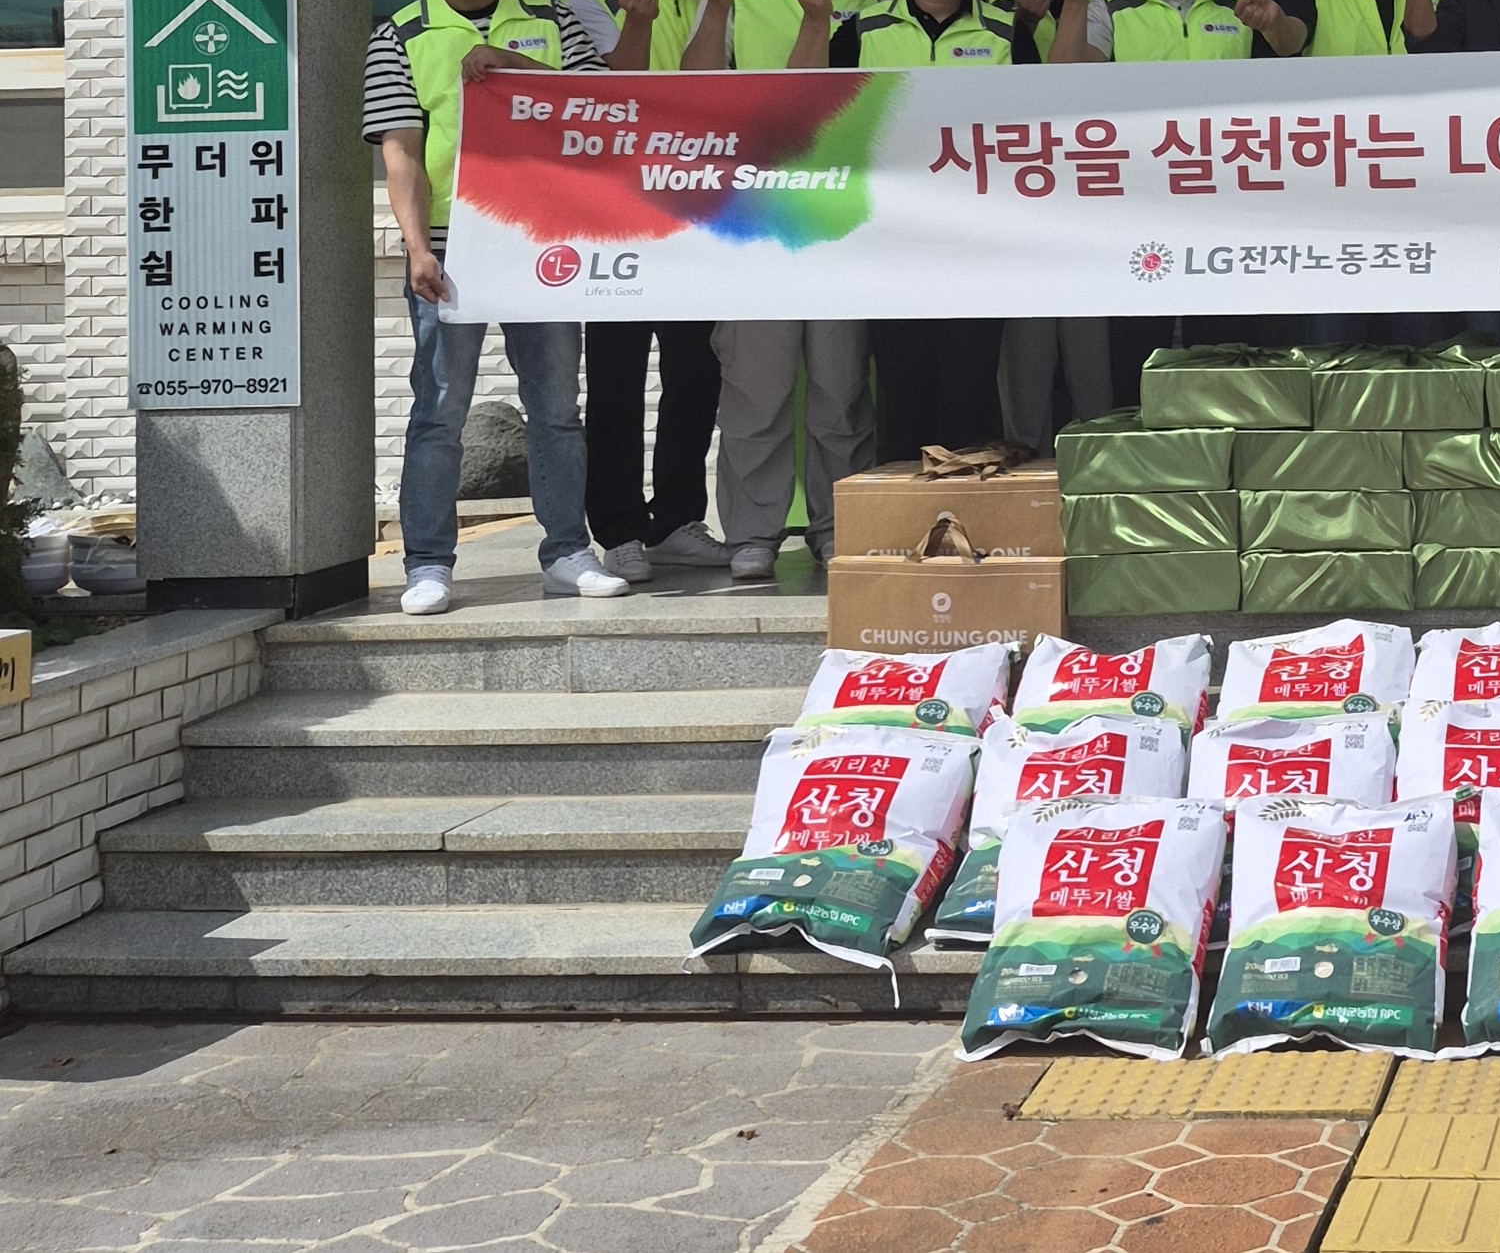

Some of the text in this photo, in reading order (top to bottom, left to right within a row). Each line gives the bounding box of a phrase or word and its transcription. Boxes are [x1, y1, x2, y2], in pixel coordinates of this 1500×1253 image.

[511, 95, 640, 123] Be First
[561, 129, 740, 162] Do it Right
[929, 118, 1130, 198] 사랑을
[1151, 113, 1425, 196] 실천하는
[640, 164, 851, 192] Work Smart!
[588, 251, 641, 281] LG
[1184, 240, 1437, 277] LG전자노동조합
[615, 286, 644, 297] Good
[161, 294, 270, 311] COOLING
[159, 320, 272, 336] WARMING
[168, 346, 264, 362] CENTER
[154, 377, 288, 396] 055-970-8921
[849, 686, 927, 701] 메뚜기쌀
[1063, 677, 1140, 693] 메뚜기쌀
[1273, 682, 1351, 697] 메뚜기쌀
[822, 757, 892, 775] 지리산
[792, 783, 887, 828] 산청
[1049, 847, 1146, 886] 산청
[1282, 847, 1378, 892] 산청
[1049, 887, 1137, 910] 메뚜기쌀
[723, 900, 747, 915] NH
[839, 911, 862, 926] RPC
[1128, 919, 1161, 935] 우수상
[1371, 915, 1402, 931] 우수상
[1379, 1008, 1402, 1020] RPC
